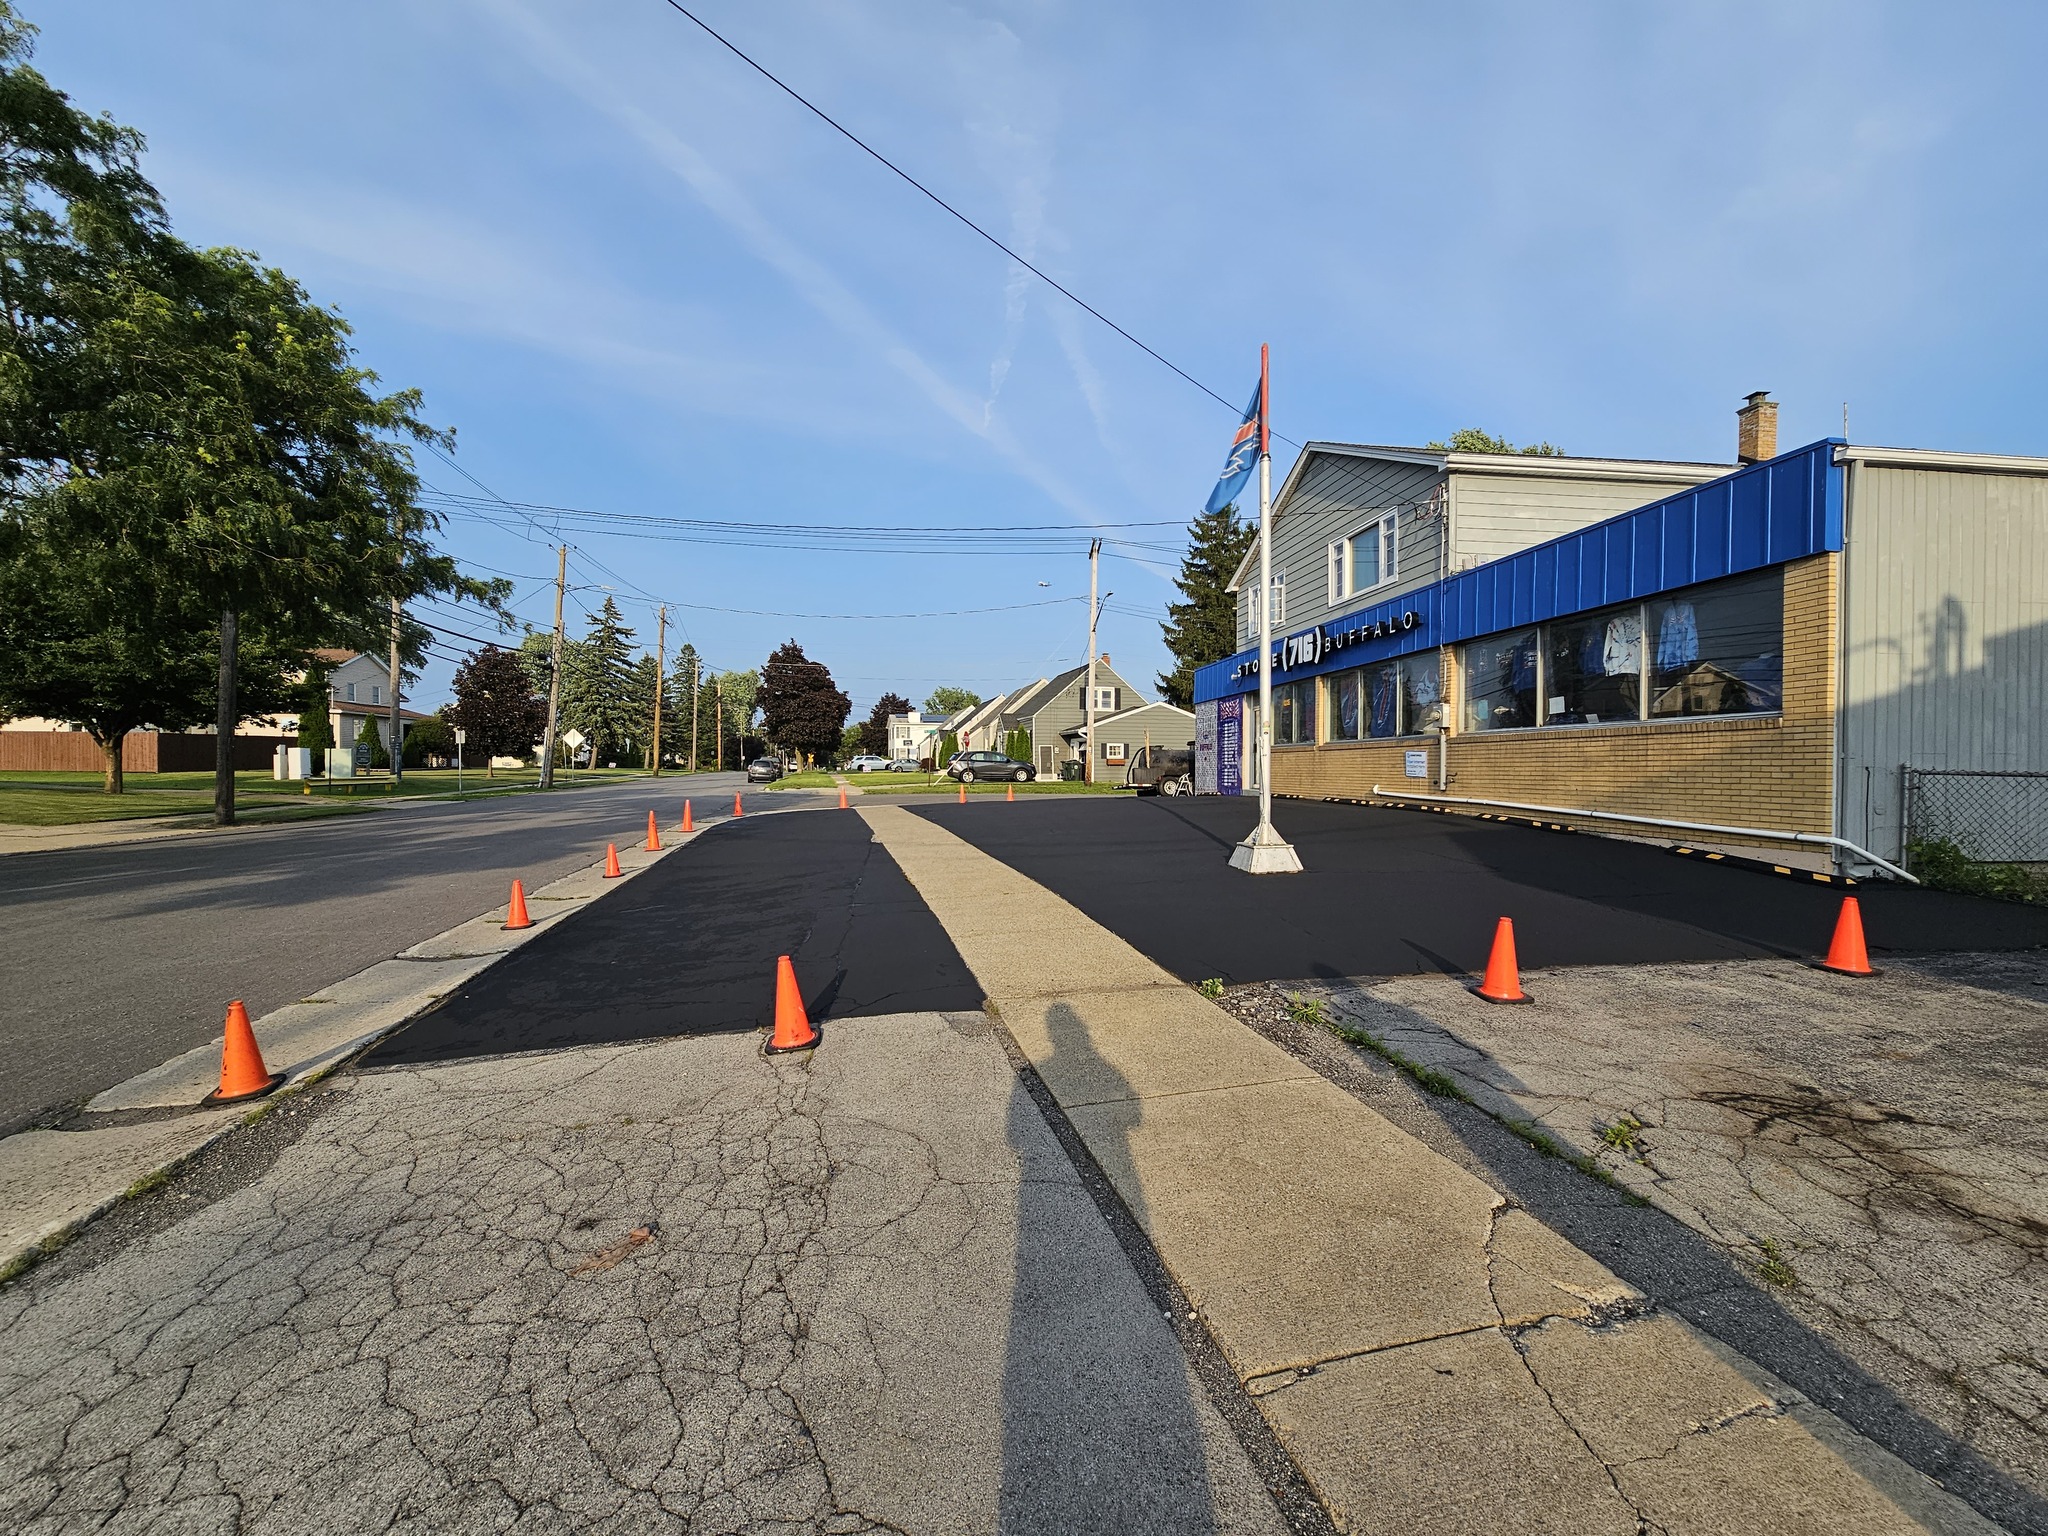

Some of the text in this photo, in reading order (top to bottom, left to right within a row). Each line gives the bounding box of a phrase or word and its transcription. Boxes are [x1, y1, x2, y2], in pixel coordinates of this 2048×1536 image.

[1237, 611, 1412, 678] STOE (716) BUFFALO
